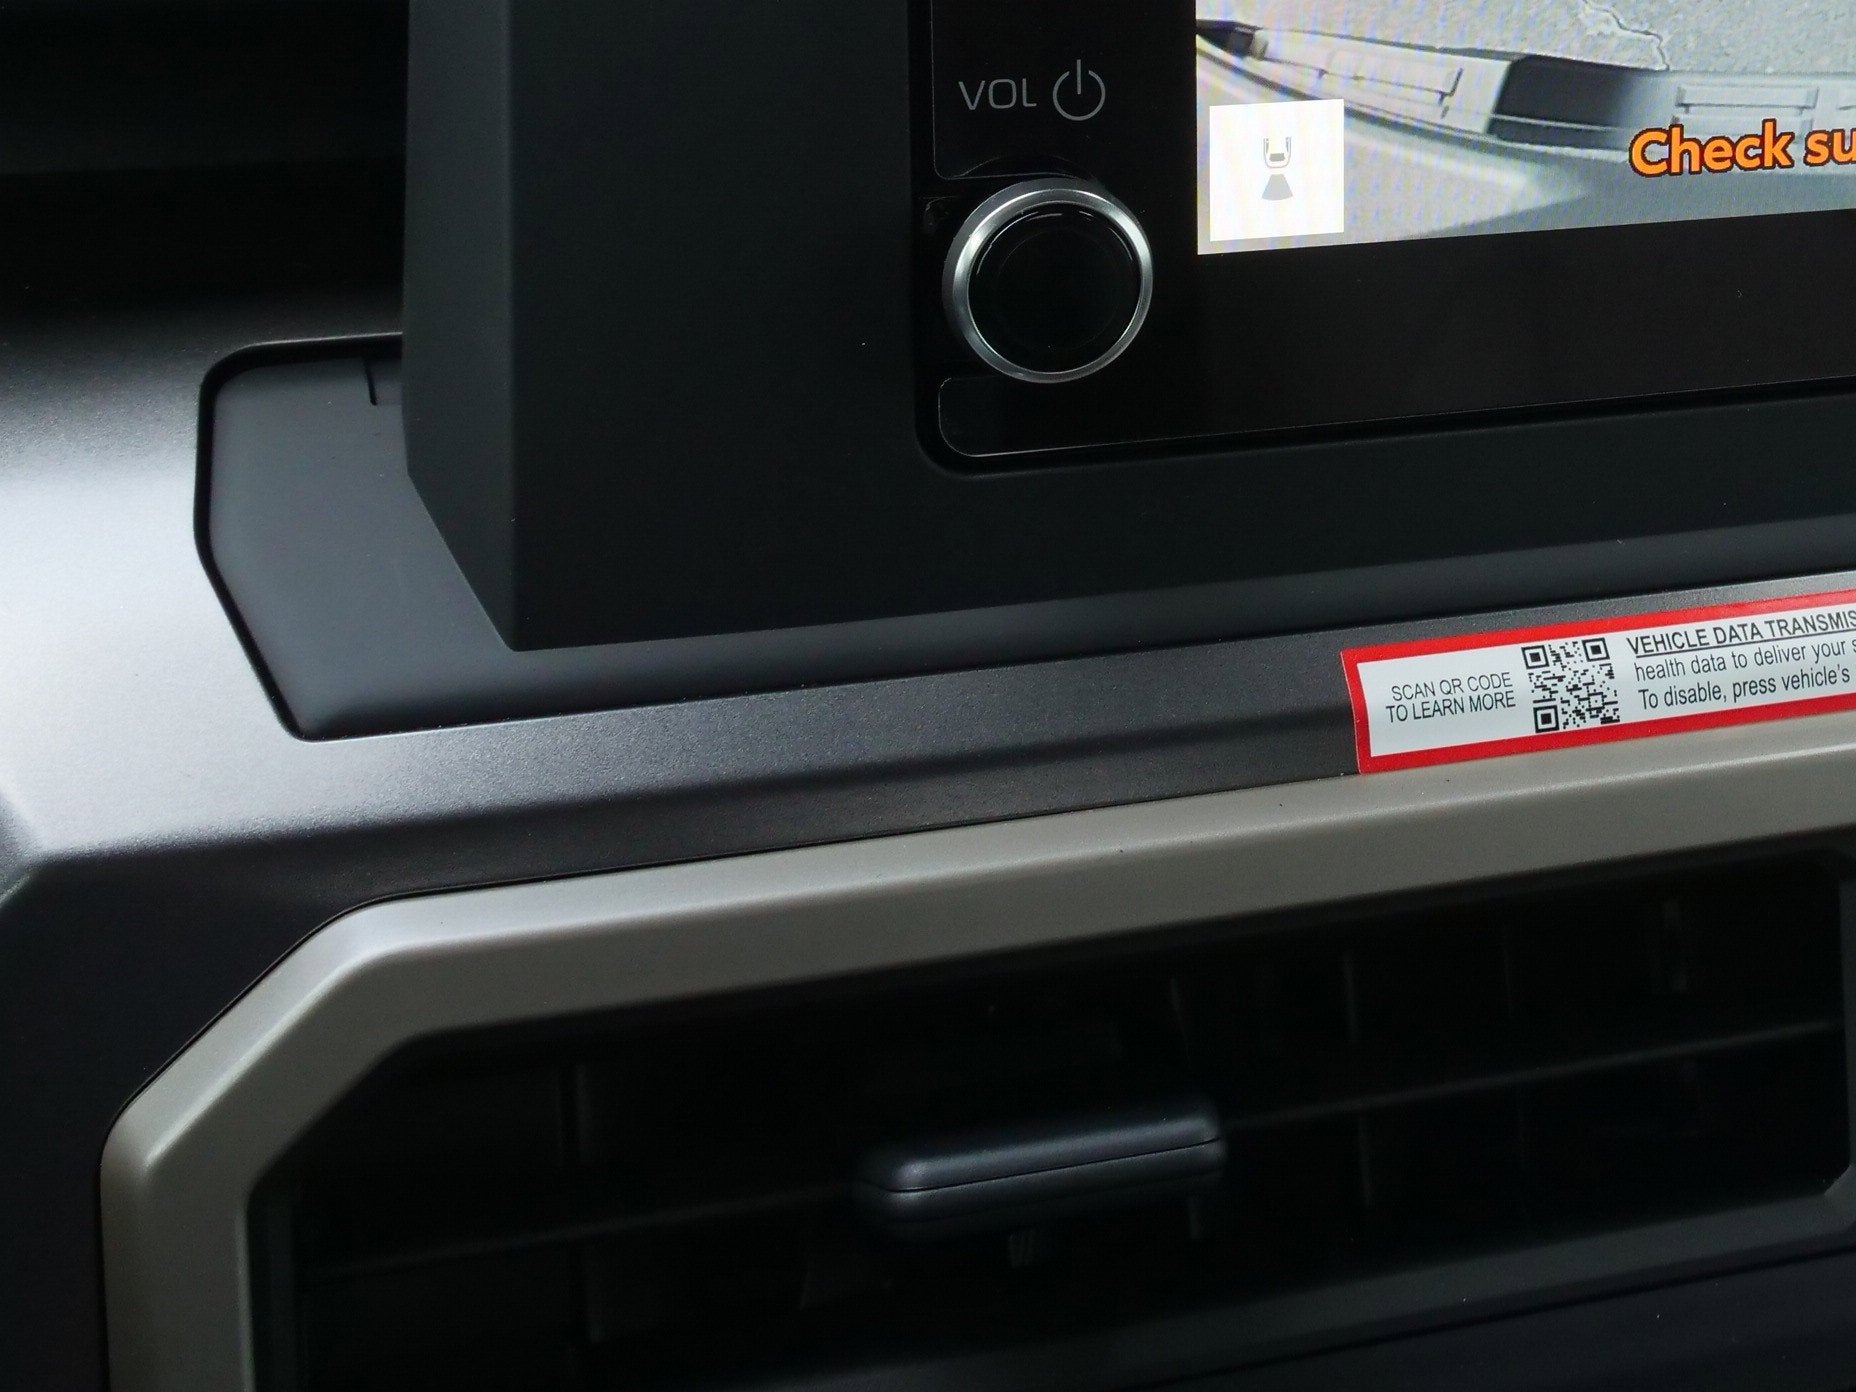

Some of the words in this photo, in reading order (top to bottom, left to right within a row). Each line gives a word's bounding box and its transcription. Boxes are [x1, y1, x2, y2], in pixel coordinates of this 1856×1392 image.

[958, 78, 1037, 110] VOL
[1629, 120, 1793, 178] Check
[1627, 629, 1709, 654] VEHICLE
[1713, 623, 1763, 645] DATA
[1635, 657, 1686, 681] health
[1691, 654, 1727, 674] data
[1732, 651, 1748, 668] to
[1754, 644, 1806, 666] deliver
[1808, 640, 1846, 663] your
[1391, 681, 1436, 701] SCAN
[1439, 677, 1463, 696] QR
[1467, 672, 1513, 692] CODE
[1638, 689, 1658, 710] To
[1664, 680, 1727, 705] disable,
[1733, 675, 1777, 703] press
[1781, 664, 1850, 691] vehicle's
[1386, 705, 1408, 723] TO
[1412, 699, 1465, 720] LEARN
[1469, 691, 1516, 712] MORE
